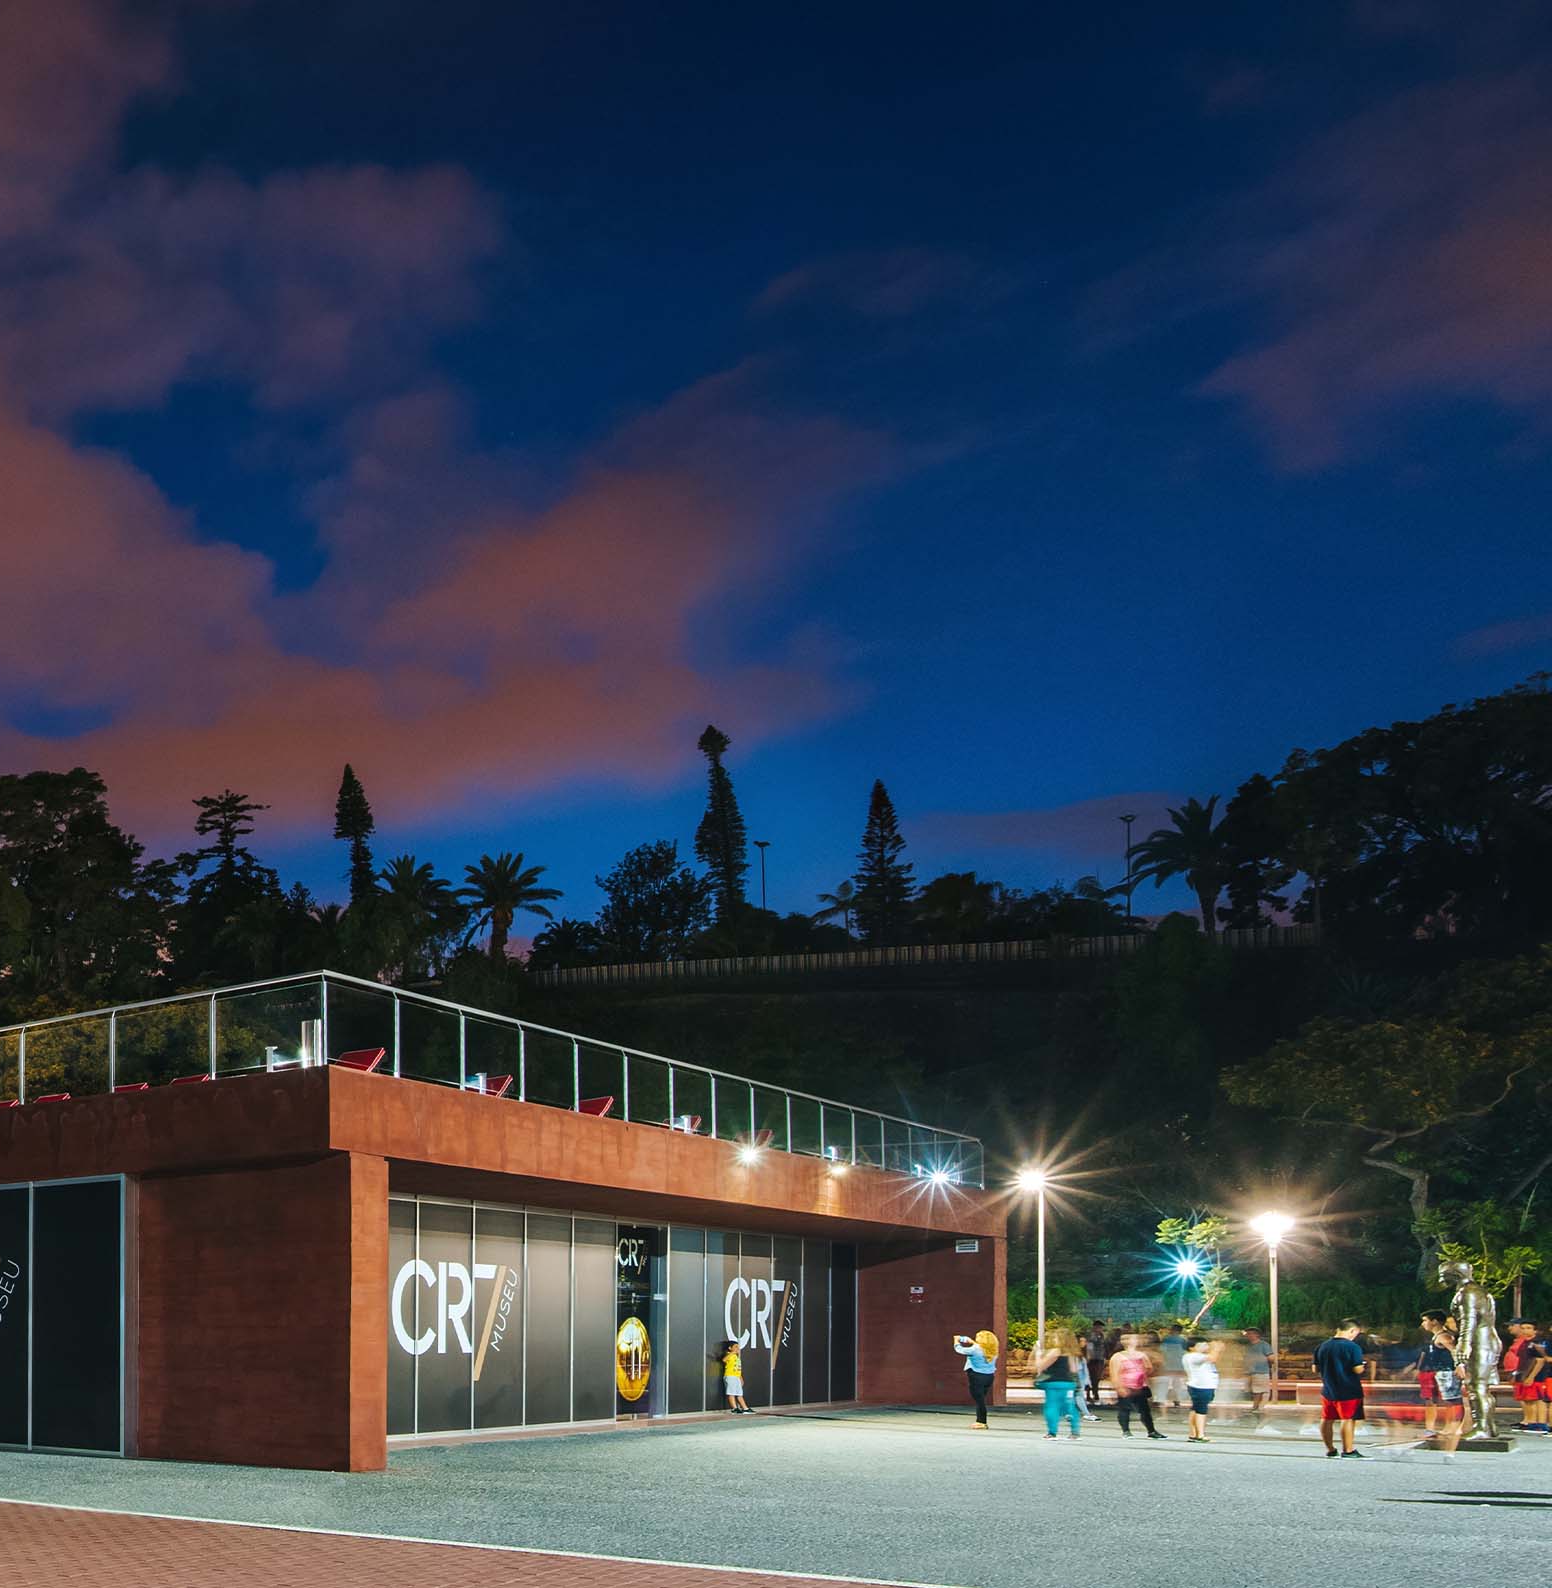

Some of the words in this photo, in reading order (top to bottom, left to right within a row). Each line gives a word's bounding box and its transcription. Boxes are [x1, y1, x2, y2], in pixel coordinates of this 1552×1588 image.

[391, 1258, 507, 1381] CR7
[490, 1268, 519, 1352] MUSEU
[724, 1276, 792, 1371] CR7
[781, 1282, 798, 1348] MUSEU
